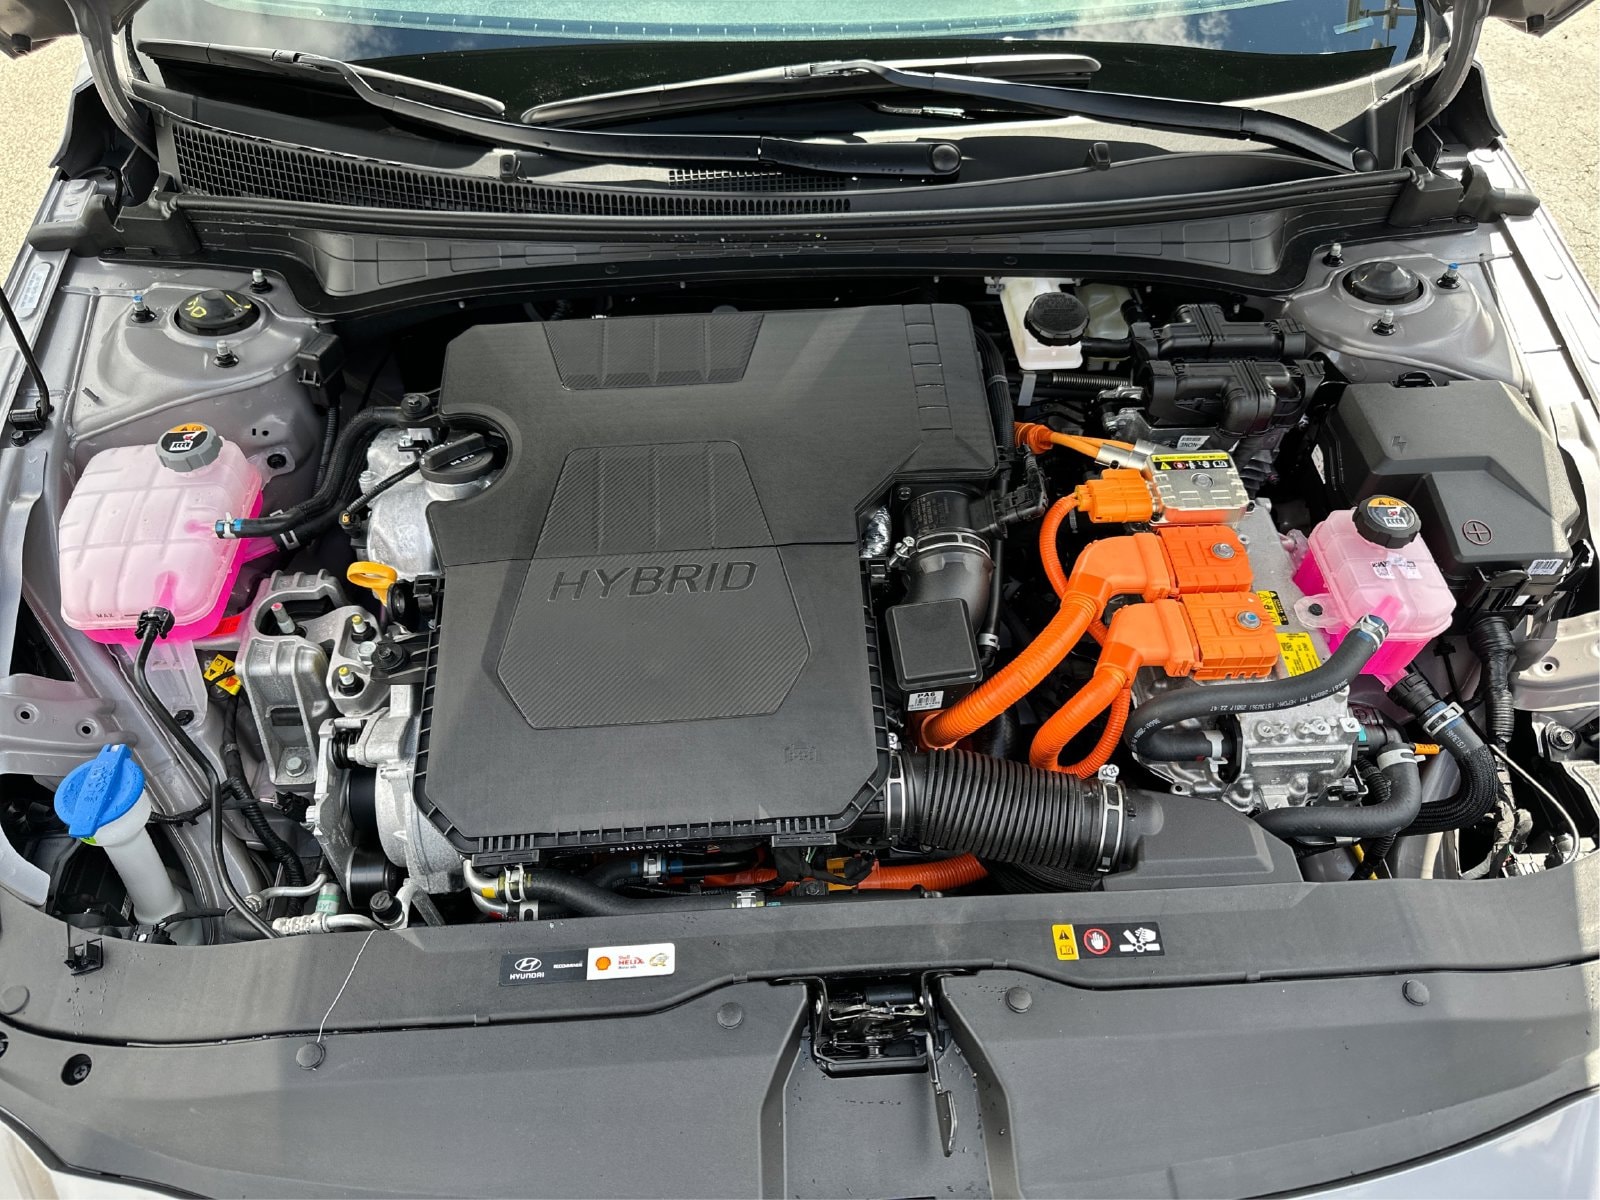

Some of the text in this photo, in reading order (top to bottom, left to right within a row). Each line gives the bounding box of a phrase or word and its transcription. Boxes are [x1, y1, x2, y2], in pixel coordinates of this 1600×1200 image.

[548, 560, 759, 602] HYBRID
[618, 956, 645, 965] HELIX
[509, 971, 545, 981] HYUNDAI
